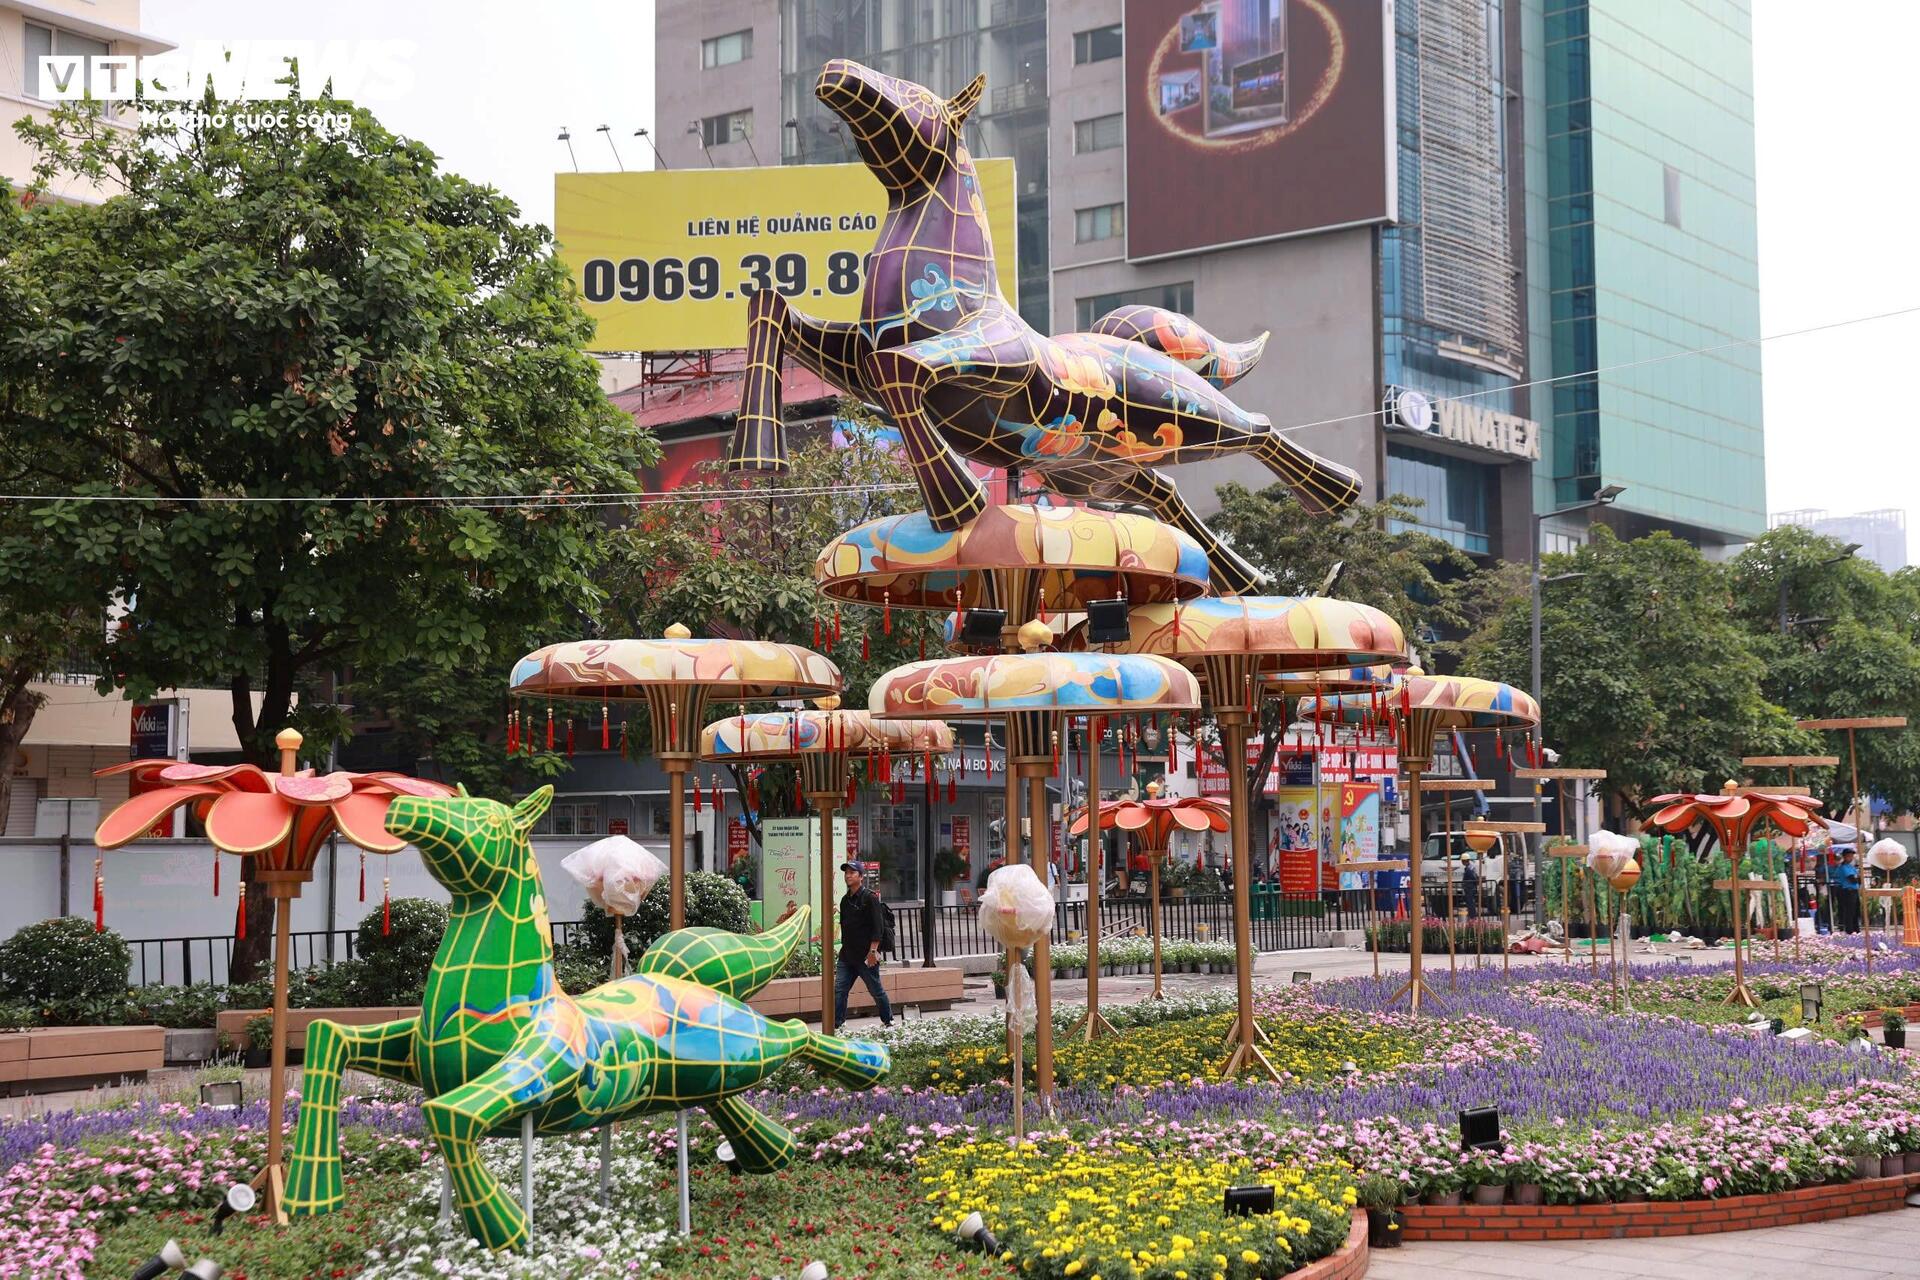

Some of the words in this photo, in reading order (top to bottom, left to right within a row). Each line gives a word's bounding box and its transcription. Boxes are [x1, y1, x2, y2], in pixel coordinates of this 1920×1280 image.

[688, 217, 729, 236] LIÊN
[736, 216, 760, 237] HỆ
[767, 212, 832, 233] QUẢNG
[838, 215, 877, 231] CÁO
[584, 252, 869, 303] 0969.39.8
[1437, 397, 1541, 461] VINATEX
[133, 710, 156, 732] Vikki
[948, 758, 971, 770] NAM
